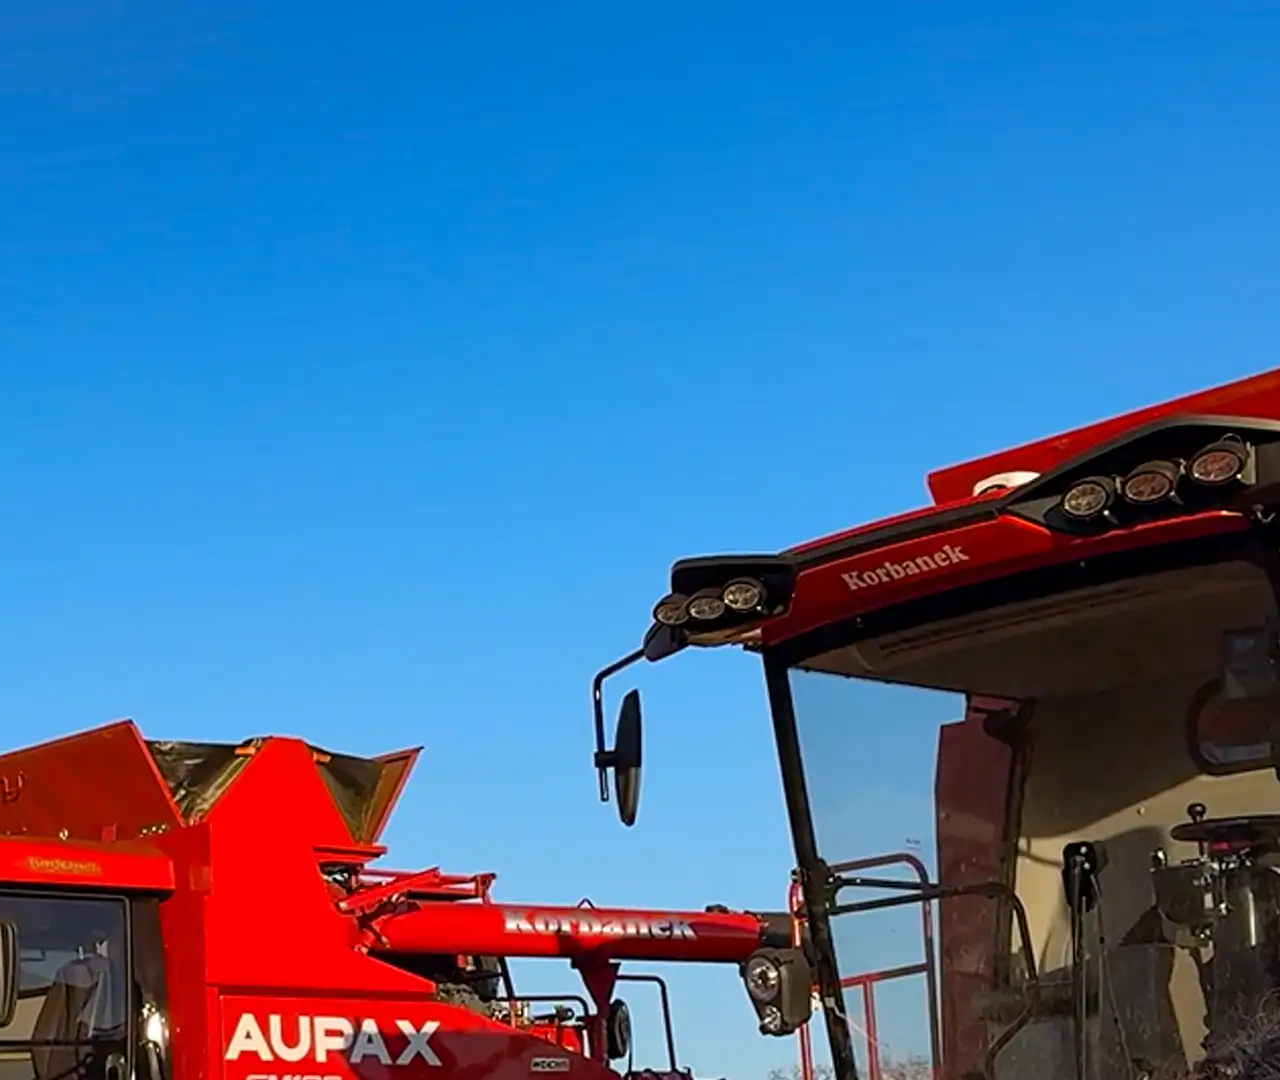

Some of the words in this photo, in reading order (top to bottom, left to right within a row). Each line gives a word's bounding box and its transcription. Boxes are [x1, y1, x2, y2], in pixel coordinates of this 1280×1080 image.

[841, 545, 969, 590] Korbanek
[504, 908, 697, 940] Korbanek
[225, 1013, 442, 1066] AUPAX
